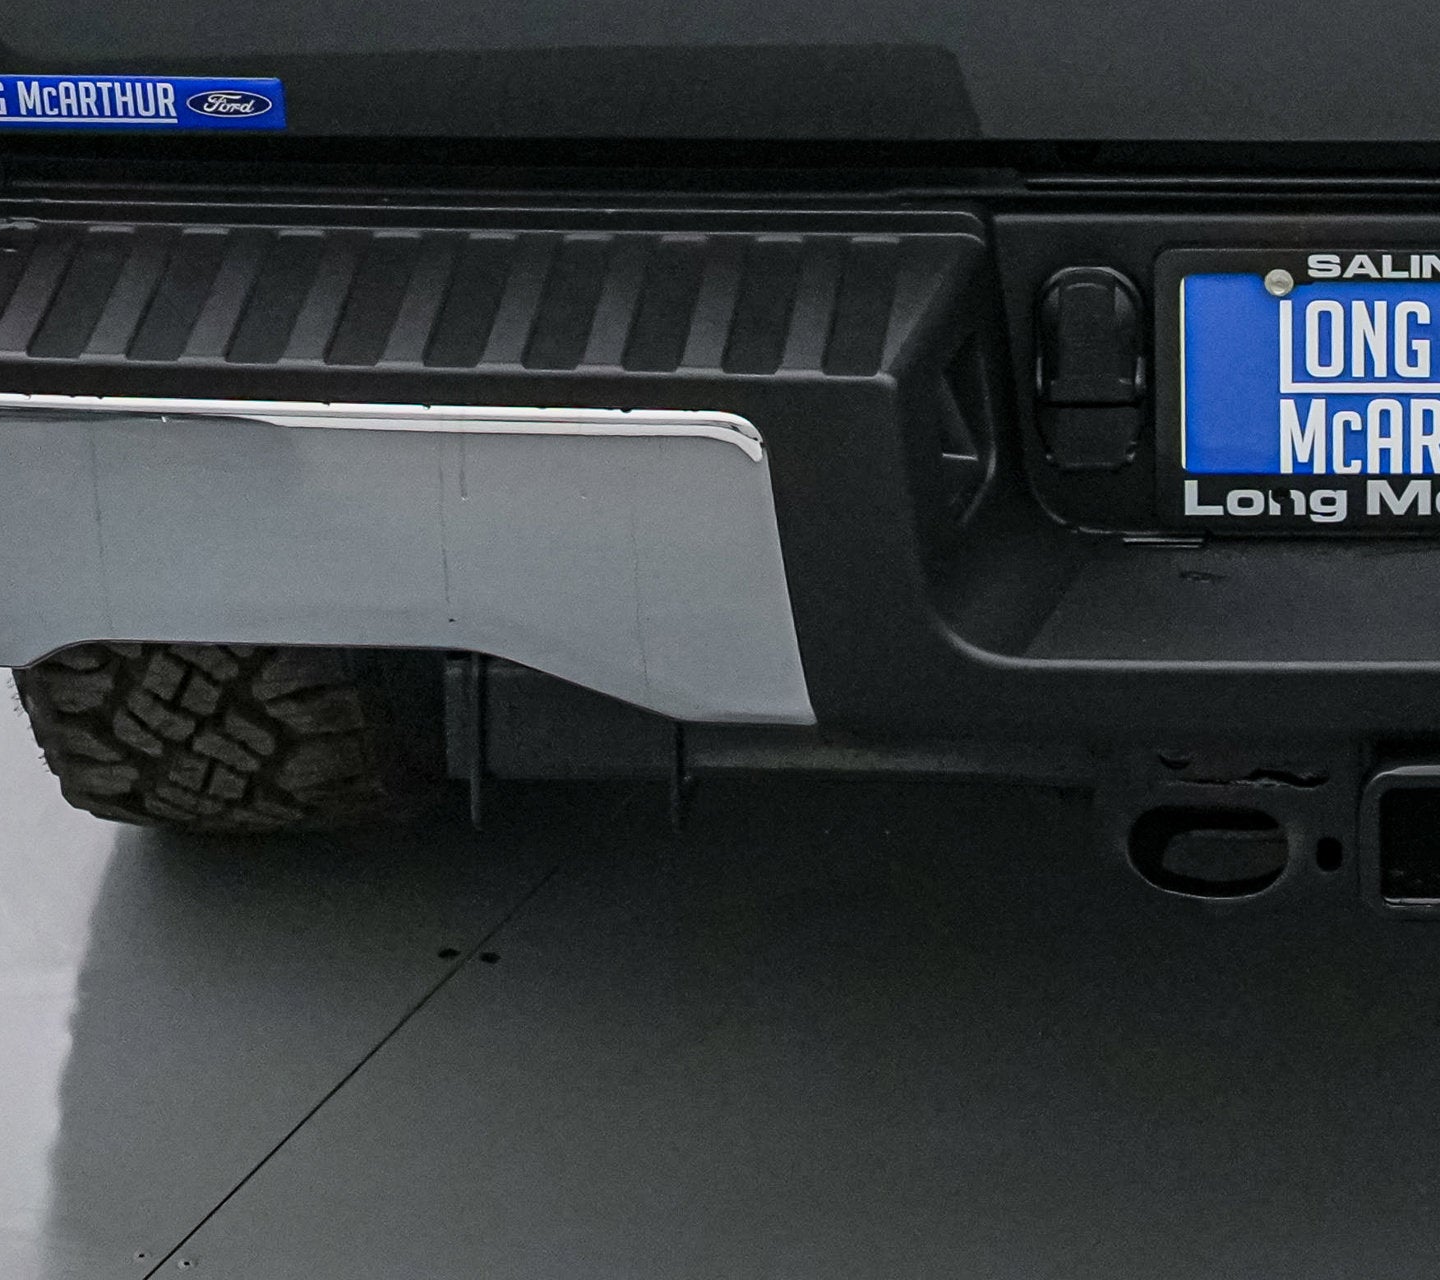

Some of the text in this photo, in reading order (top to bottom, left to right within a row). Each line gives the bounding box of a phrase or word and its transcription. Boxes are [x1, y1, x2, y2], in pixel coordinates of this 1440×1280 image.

[16, 80, 178, 117] McARTHUR
[203, 93, 255, 113] Ford
[1279, 299, 1431, 392] LONG
[1184, 480, 1348, 523] Long
